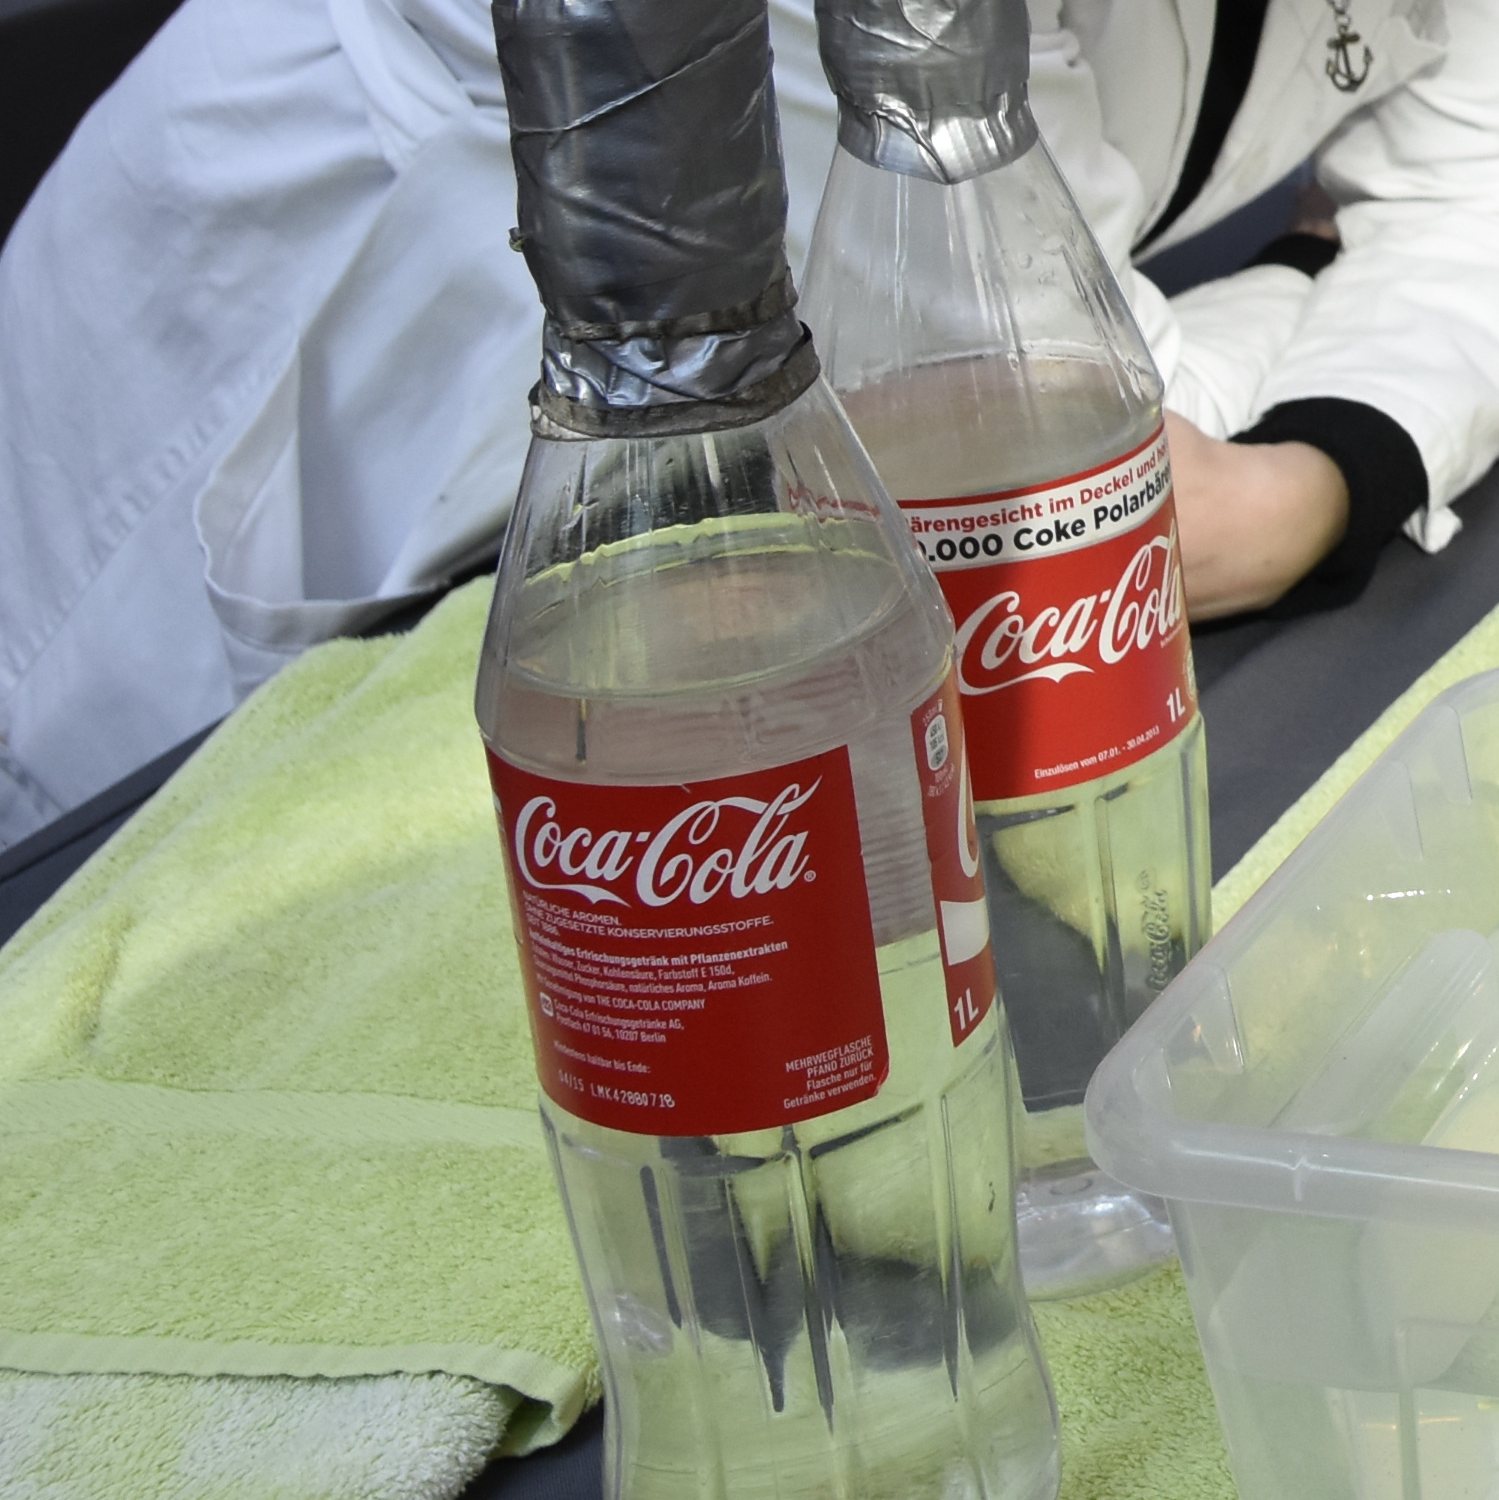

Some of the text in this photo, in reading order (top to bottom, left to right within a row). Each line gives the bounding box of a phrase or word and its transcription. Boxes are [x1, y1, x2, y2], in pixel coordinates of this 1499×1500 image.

[905, 503, 1044, 533] ärengesicht
[1049, 496, 1075, 515] im
[1079, 468, 1135, 505] Deckel
[1136, 451, 1157, 479] und
[1012, 517, 1087, 552] Coke
[954, 535, 1182, 695] Coca-Cola
[1166, 687, 1186, 723] 1L
[1033, 758, 1080, 779] Einzulösen
[1080, 754, 1098, 768] vom
[1097, 746, 1122, 762] 07.01.
[515, 775, 823, 908] Coca-Cola
[544, 912, 607, 937] ZUGESETZTE
[606, 915, 775, 939] KONSERVIERUNGSSTOFFE.
[572, 911, 623, 927] AROMEN.
[576, 947, 669, 968] Erfrischungsgetränk
[670, 954, 689, 966] mit
[690, 941, 789, 965] Pflanzenextrakten
[602, 965, 658, 981] Kohlensäure,
[657, 967, 699, 981] Farbstoff
[700, 967, 707, 978] E
[709, 964, 736, 978] 150d,
[628, 980, 675, 994] natürliches
[675, 982, 707, 994] Aroma,
[708, 980, 737, 992] Aroma
[737, 972, 773, 988] Koffein.
[596, 994, 612, 1008] THE
[612, 997, 662, 1011] COCA-COLA
[661, 998, 707, 1012] COMPANY
[953, 987, 980, 1032] 1L
[584, 1008, 668, 1031] Erfrischungsgetränke
[668, 1018, 686, 1031] AG,
[615, 1028, 640, 1043] 10207
[639, 1031, 667, 1044] Berlin
[613, 1058, 626, 1071] bis
[626, 1062, 651, 1074] Ende:
[785, 1034, 873, 1073] MEHRWEGFLASCHE
[806, 1046, 875, 1079] PFAND ZURÜCK
[783, 1072, 877, 1110] Getränke verwenden.
[806, 1060, 873, 1092] Flasche nur für
